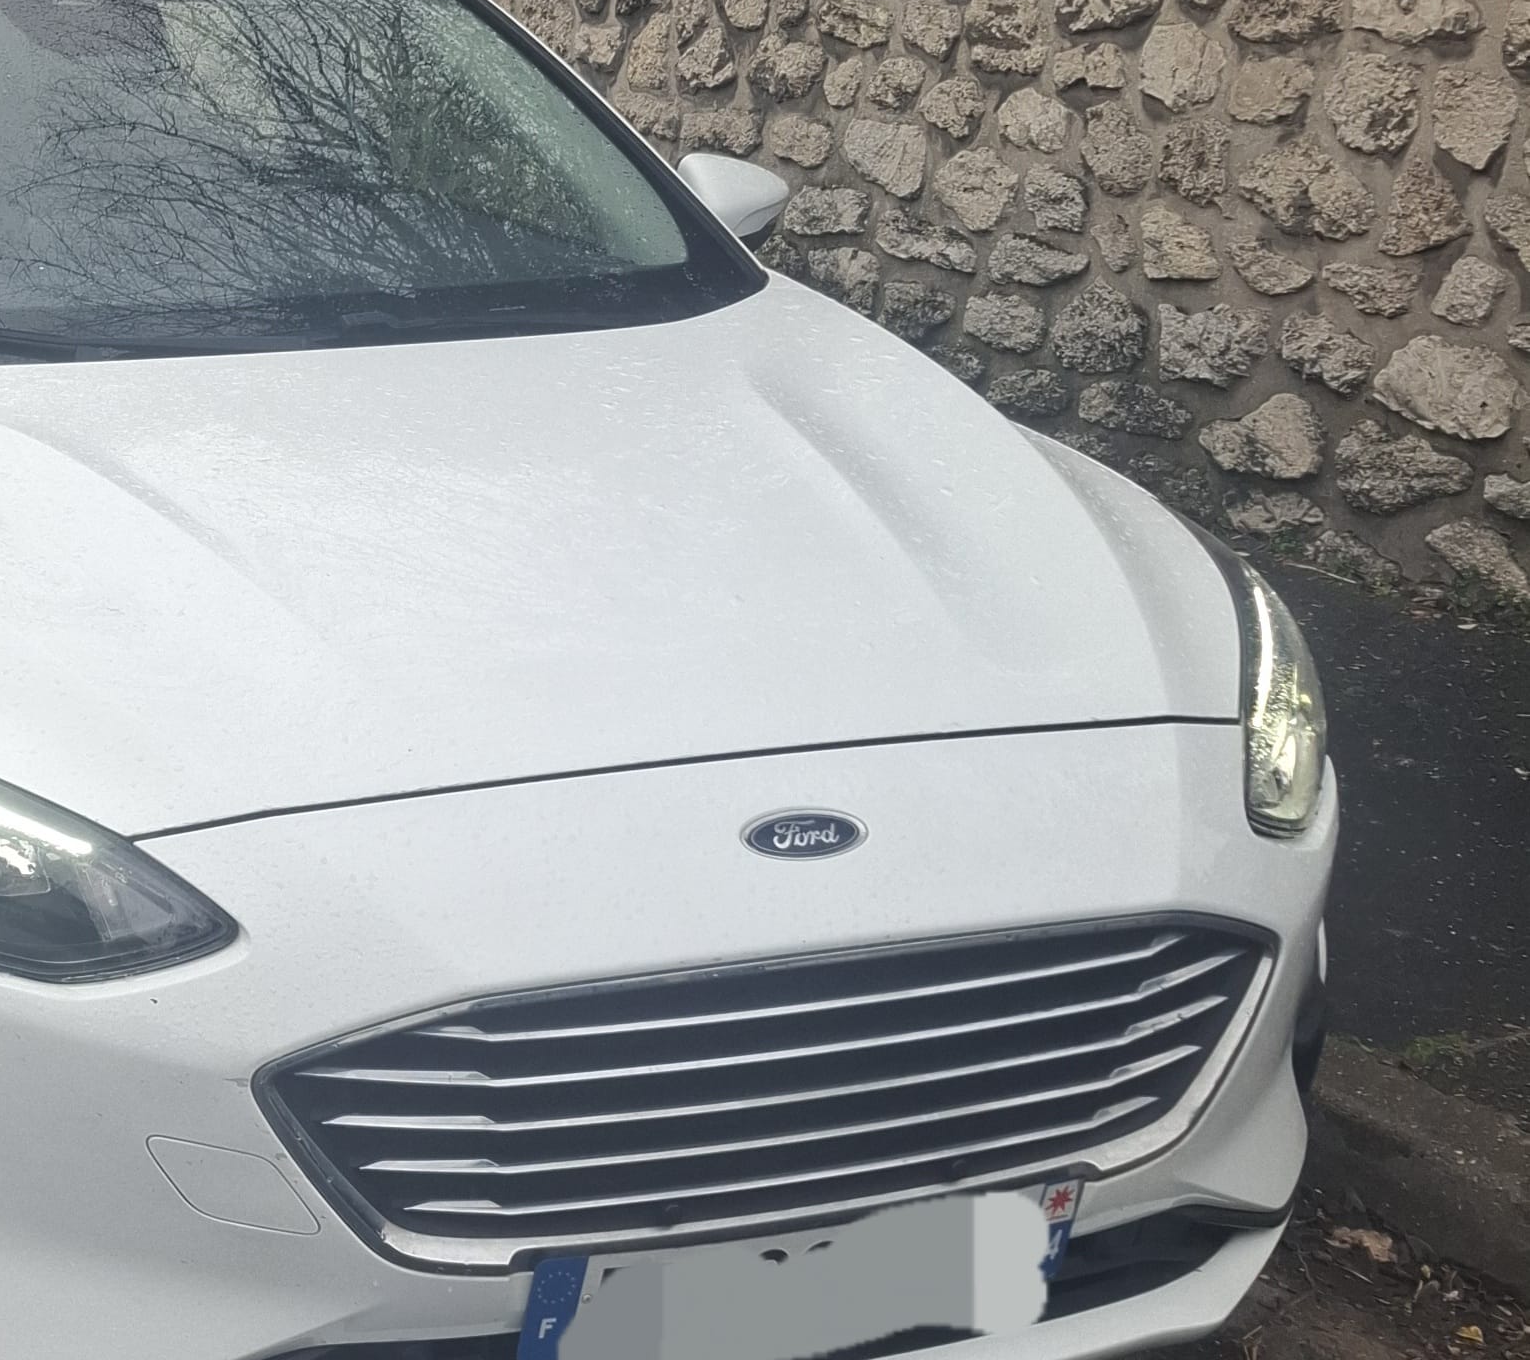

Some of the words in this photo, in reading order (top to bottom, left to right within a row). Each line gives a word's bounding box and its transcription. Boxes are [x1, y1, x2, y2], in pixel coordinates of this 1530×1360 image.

[773, 820, 840, 849] Ford
[1045, 1228, 1064, 1261] 4
[538, 1317, 557, 1339] F
